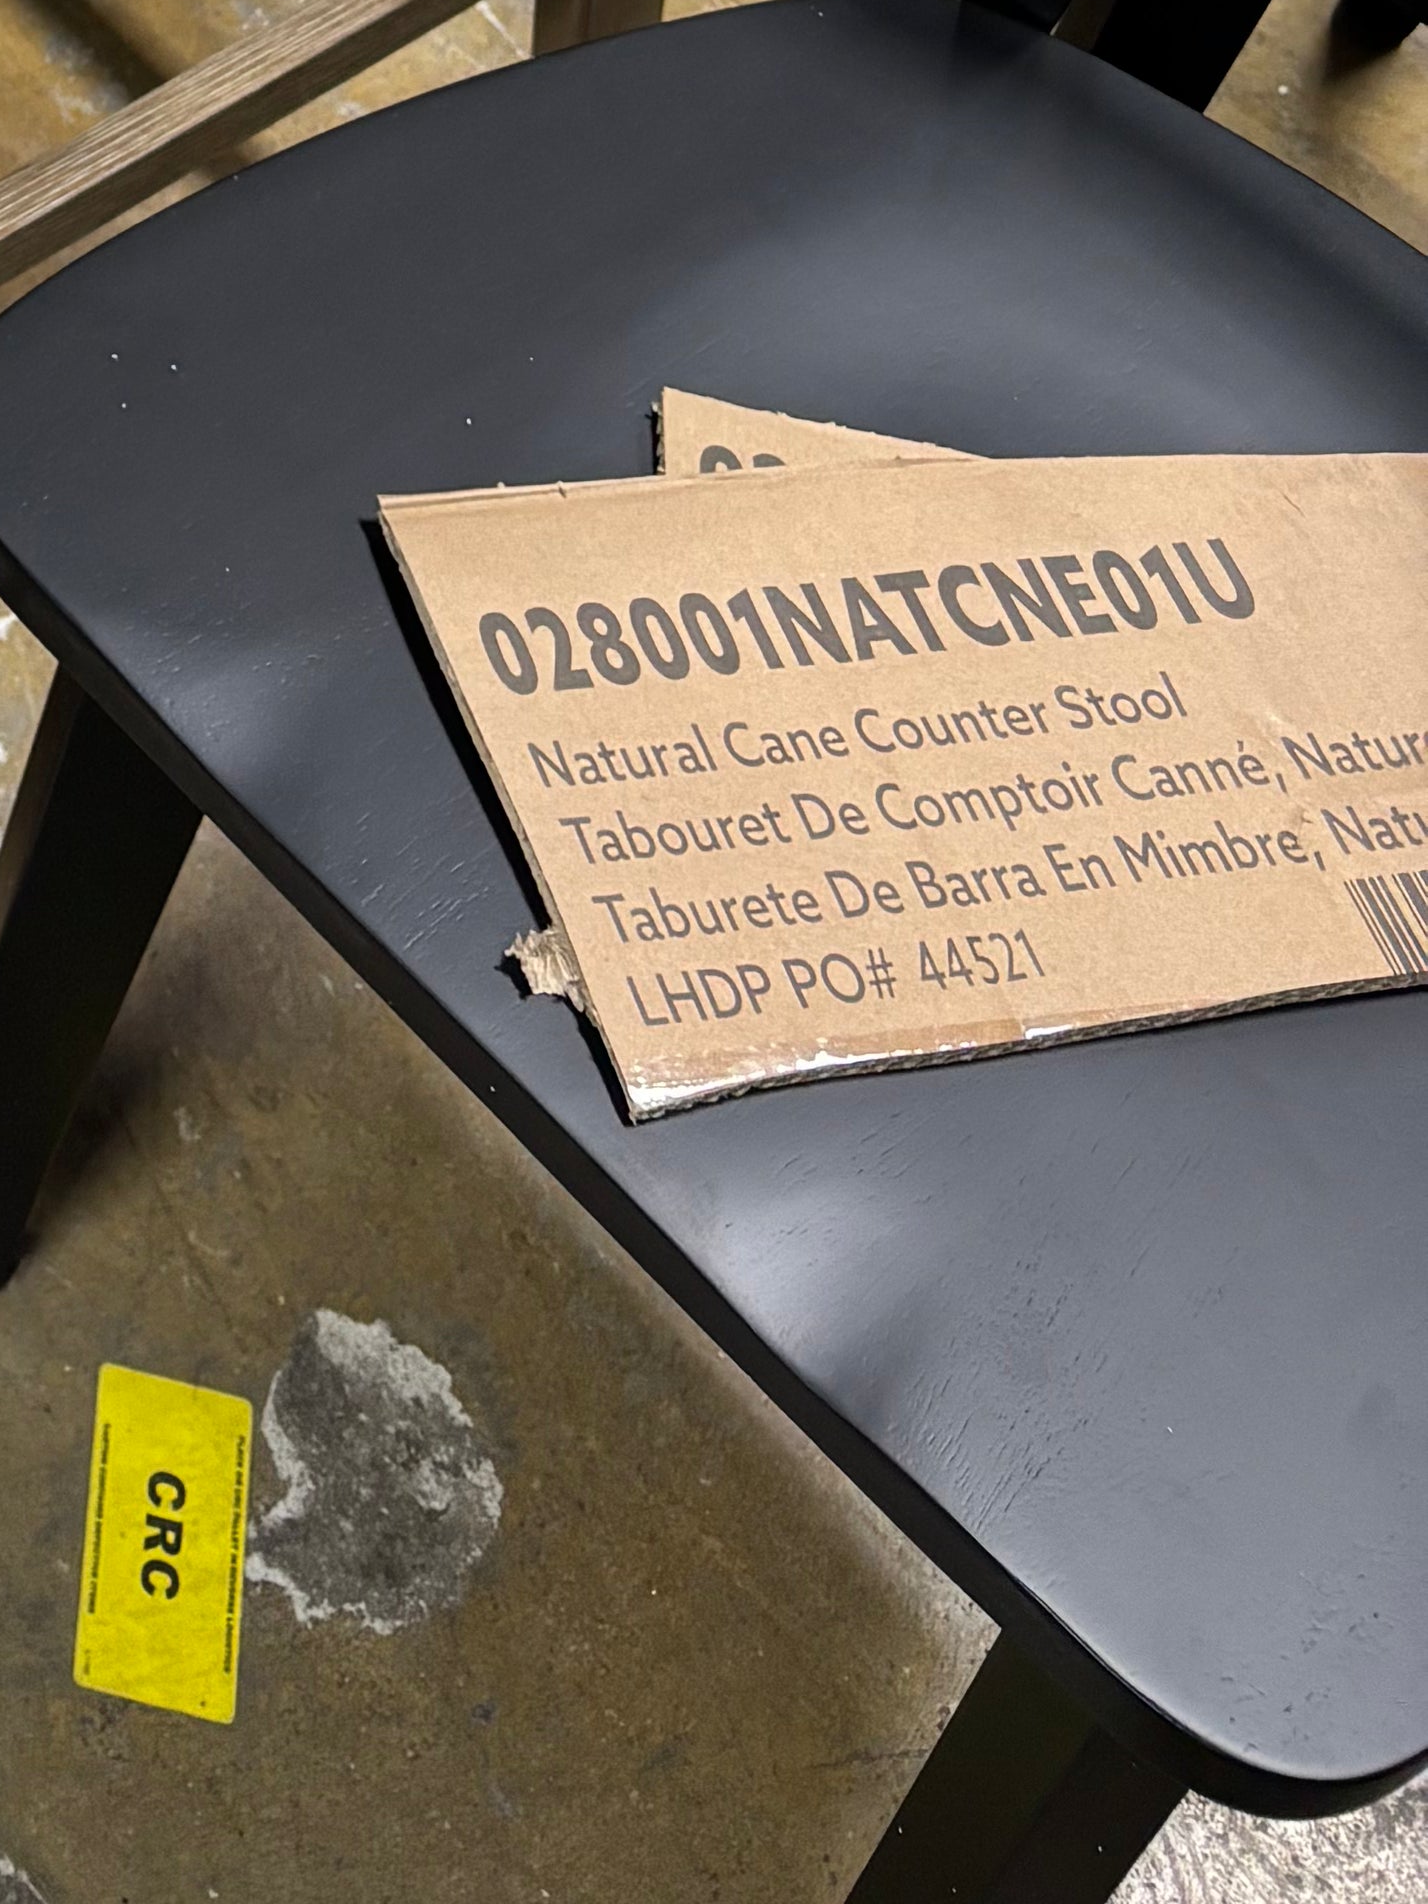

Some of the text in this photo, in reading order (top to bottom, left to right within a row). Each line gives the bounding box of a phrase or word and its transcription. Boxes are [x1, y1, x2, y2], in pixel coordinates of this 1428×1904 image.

[479, 537, 1256, 696] 028001NATCNE01U
[527, 671, 1187, 788] Natural Cane Counter Stool
[559, 731, 1428, 865] Tabouret De Comptoir Canné, Natur
[591, 883, 823, 944] Taburete
[824, 869, 905, 920] De
[904, 860, 1047, 909] Barra
[1044, 843, 1117, 893] En
[1113, 820, 1326, 883] Mimbre,
[626, 928, 1045, 1027] LHDP PO# 44521
[140, 1471, 186, 1601] CRC
